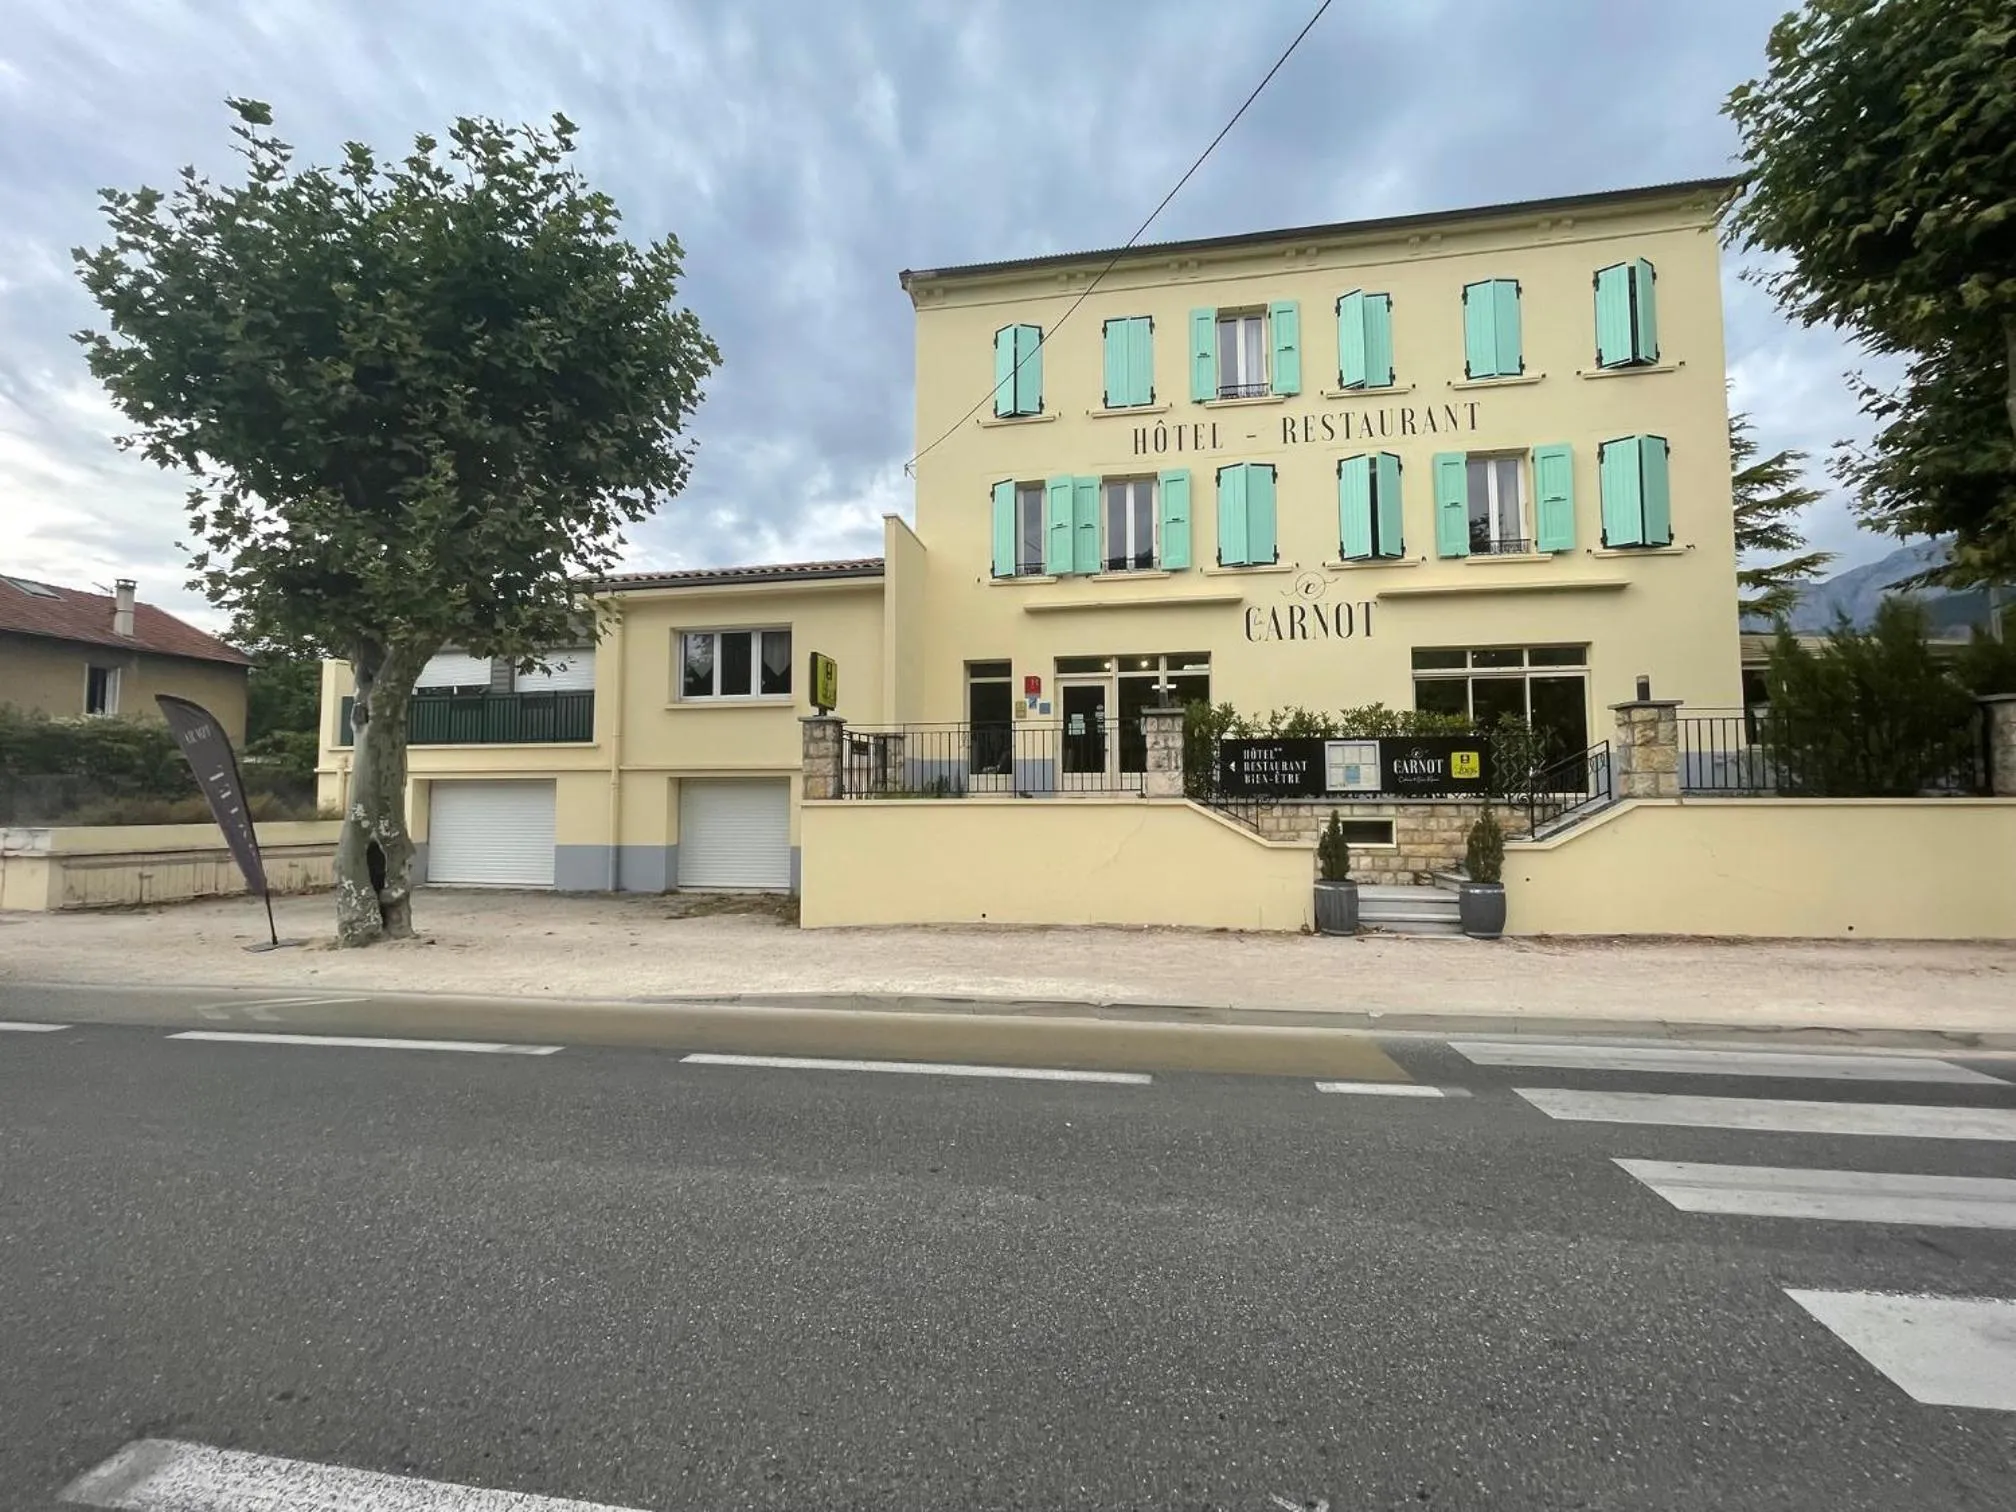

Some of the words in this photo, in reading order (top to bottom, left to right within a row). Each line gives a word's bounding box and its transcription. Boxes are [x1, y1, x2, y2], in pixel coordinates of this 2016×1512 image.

[1133, 419, 1224, 455] HÔTEL
[1282, 401, 1481, 445] RESTAURANT
[1245, 601, 1380, 642] CARNOT
[1243, 760, 1308, 772] RESTAURANT
[1393, 758, 1444, 775] CARNOT
